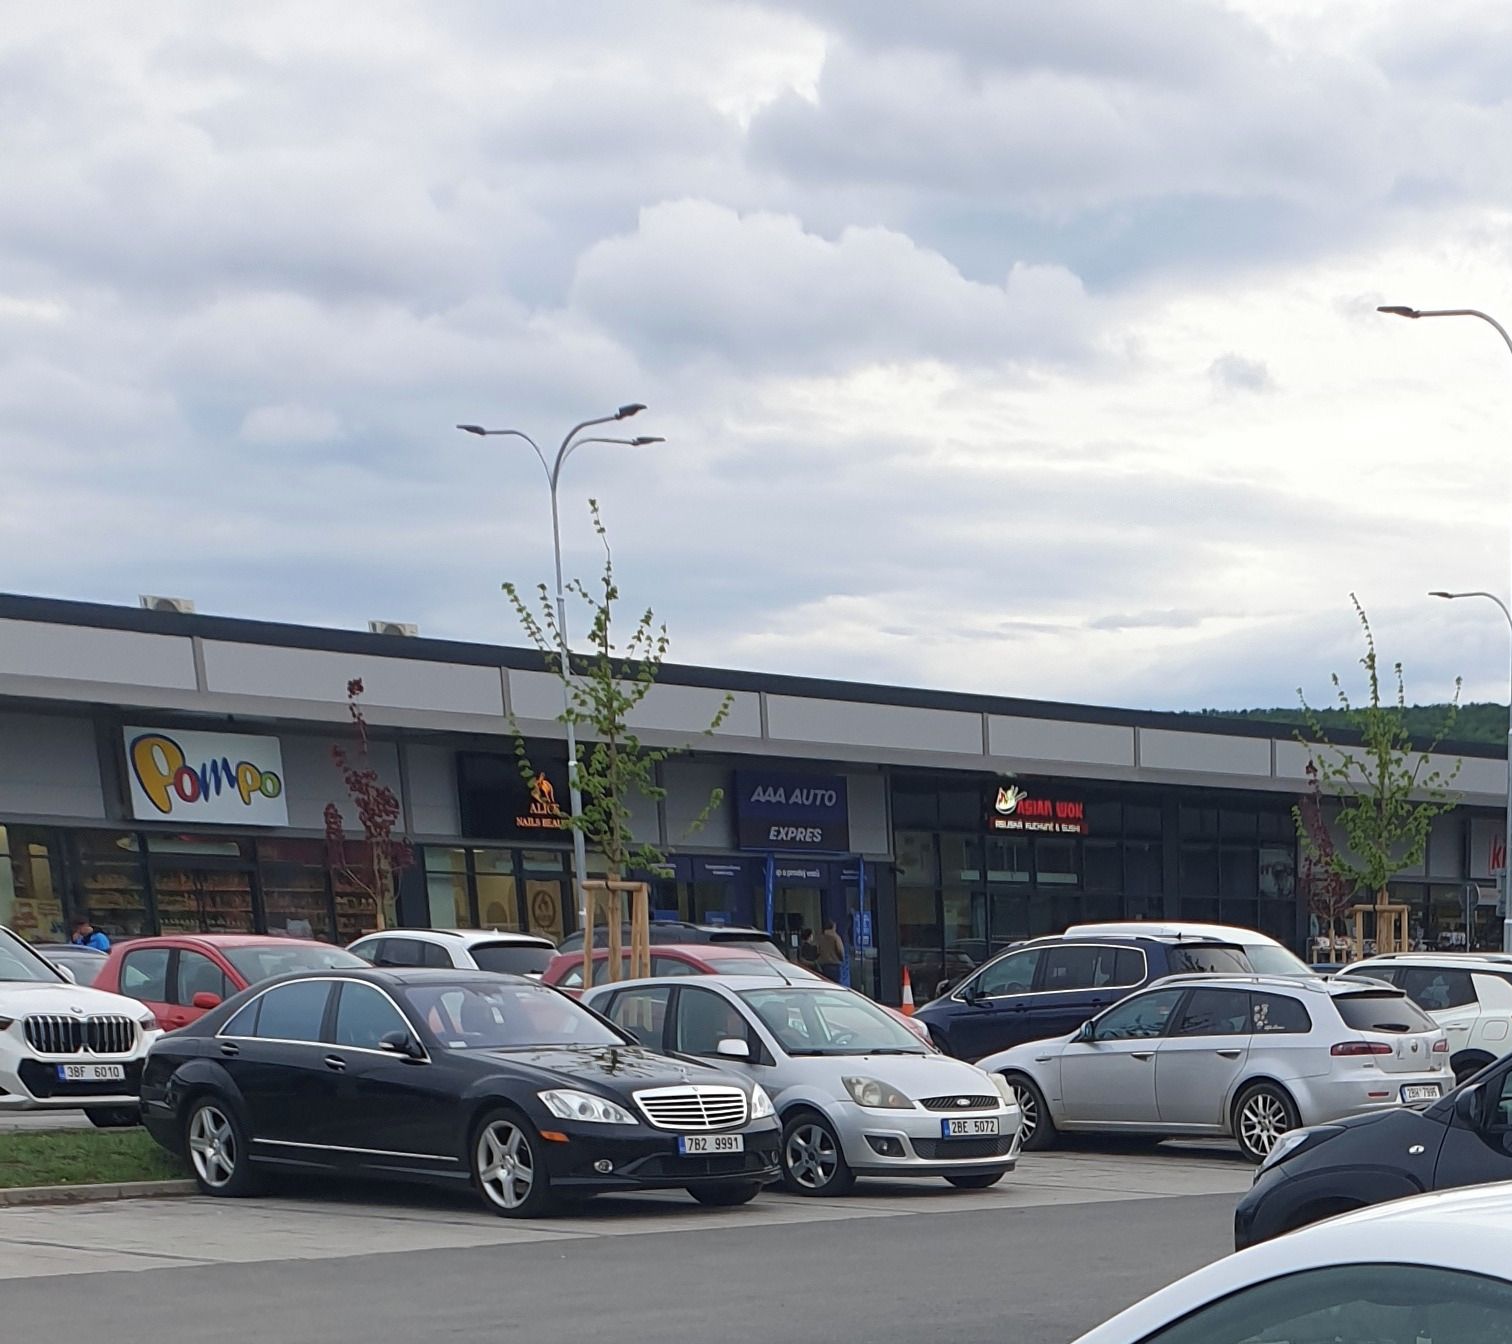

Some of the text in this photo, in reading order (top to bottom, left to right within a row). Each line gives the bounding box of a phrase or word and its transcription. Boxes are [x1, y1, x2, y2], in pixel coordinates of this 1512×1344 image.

[130, 733, 281, 814] Pompo
[751, 785, 837, 806] AAA AUTO
[1017, 800, 1084, 818] ASIAN WOK
[769, 826, 822, 842] EXPRES
[94, 1066, 120, 1078] 6010
[952, 1120, 995, 1133] 2BE 5072
[687, 1137, 739, 1151] 7B2 9991
